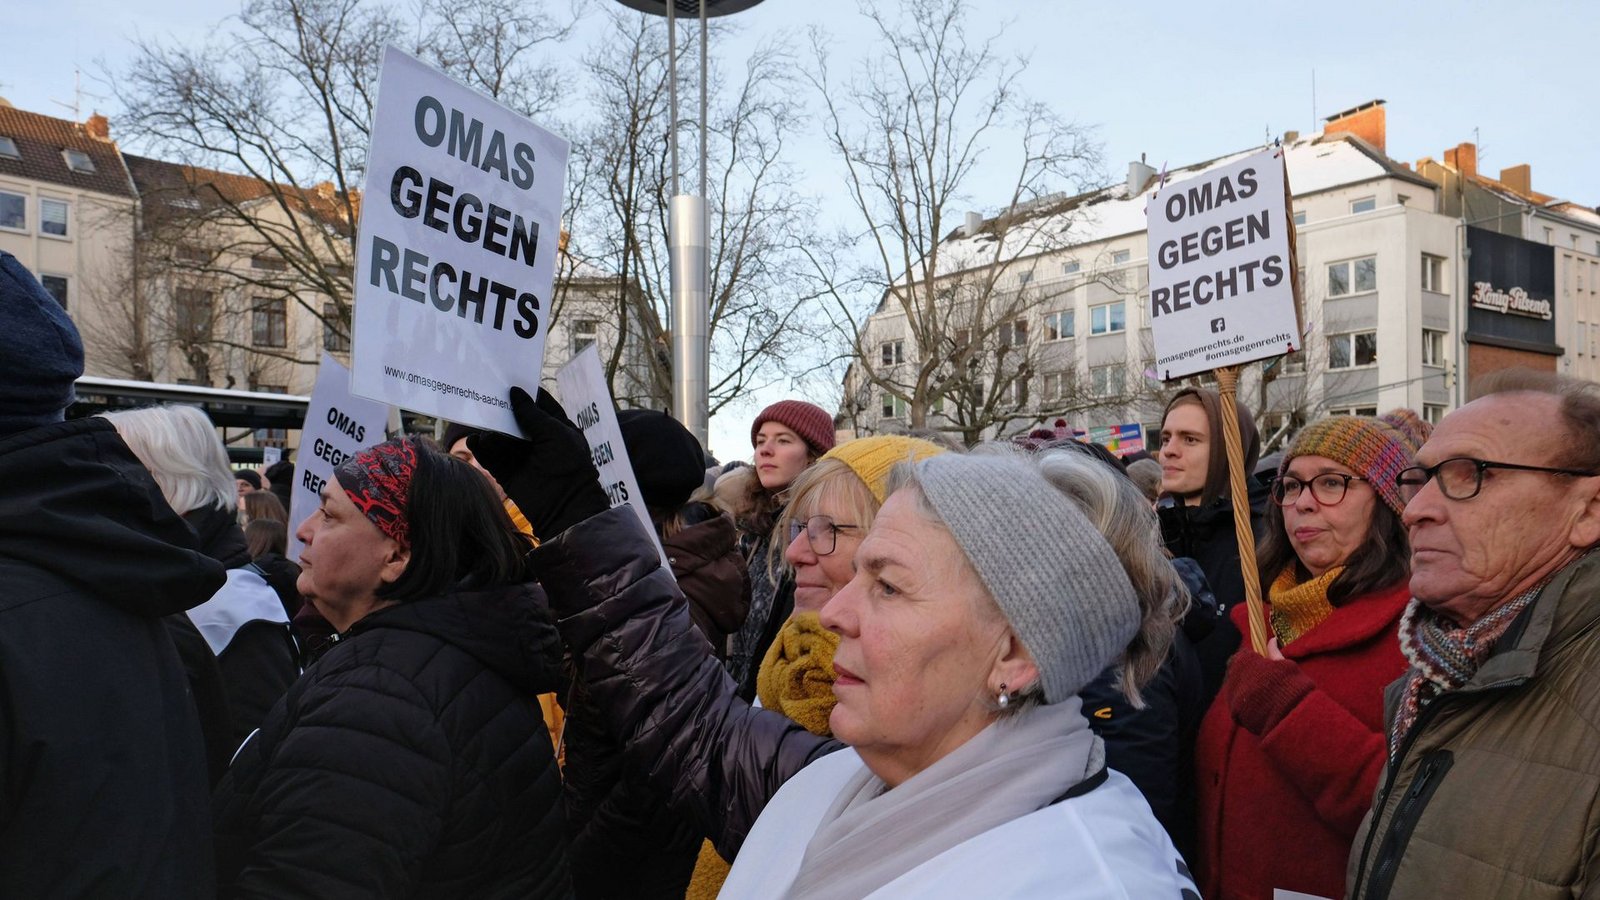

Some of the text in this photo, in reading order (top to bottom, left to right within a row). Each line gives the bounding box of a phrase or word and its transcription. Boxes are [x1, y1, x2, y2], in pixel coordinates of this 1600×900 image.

[414, 95, 536, 191] OMAS
[1165, 167, 1258, 223] OMAS
[390, 165, 540, 267] GEGEN
[1158, 209, 1271, 270] GEGEN
[369, 235, 540, 340] RECHTS
[1151, 254, 1284, 318] RECHTS
[1157, 334, 1245, 366] omasgegenrechts.de
[1205, 332, 1292, 361] #omasgegenrechts
[327, 407, 365, 443] OMAS
[577, 401, 600, 431] OMAS
[314, 438, 350, 466] GEG
[592, 441, 615, 467] GEN
[606, 480, 629, 505] HTS
